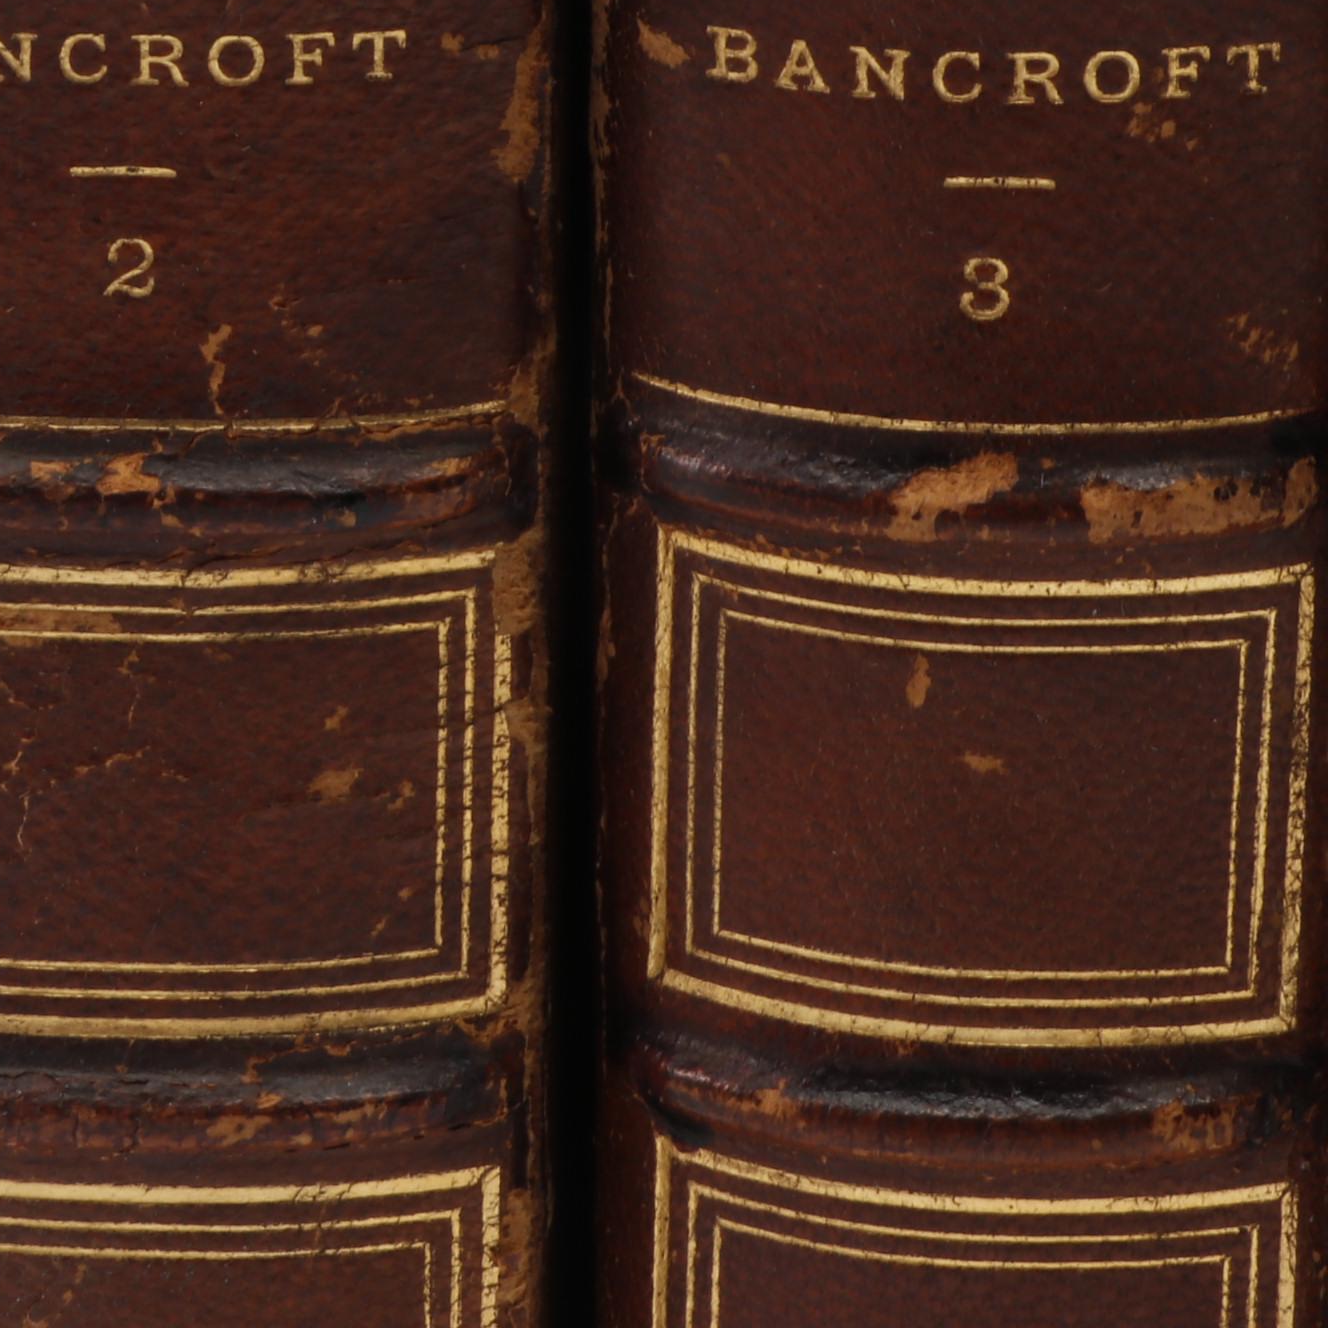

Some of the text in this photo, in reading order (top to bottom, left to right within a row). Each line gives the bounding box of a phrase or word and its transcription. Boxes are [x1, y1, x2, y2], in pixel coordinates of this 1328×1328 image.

[705, 25, 1282, 106] BANCROFT
[102, 237, 156, 297] 2
[960, 256, 1011, 321] 3
